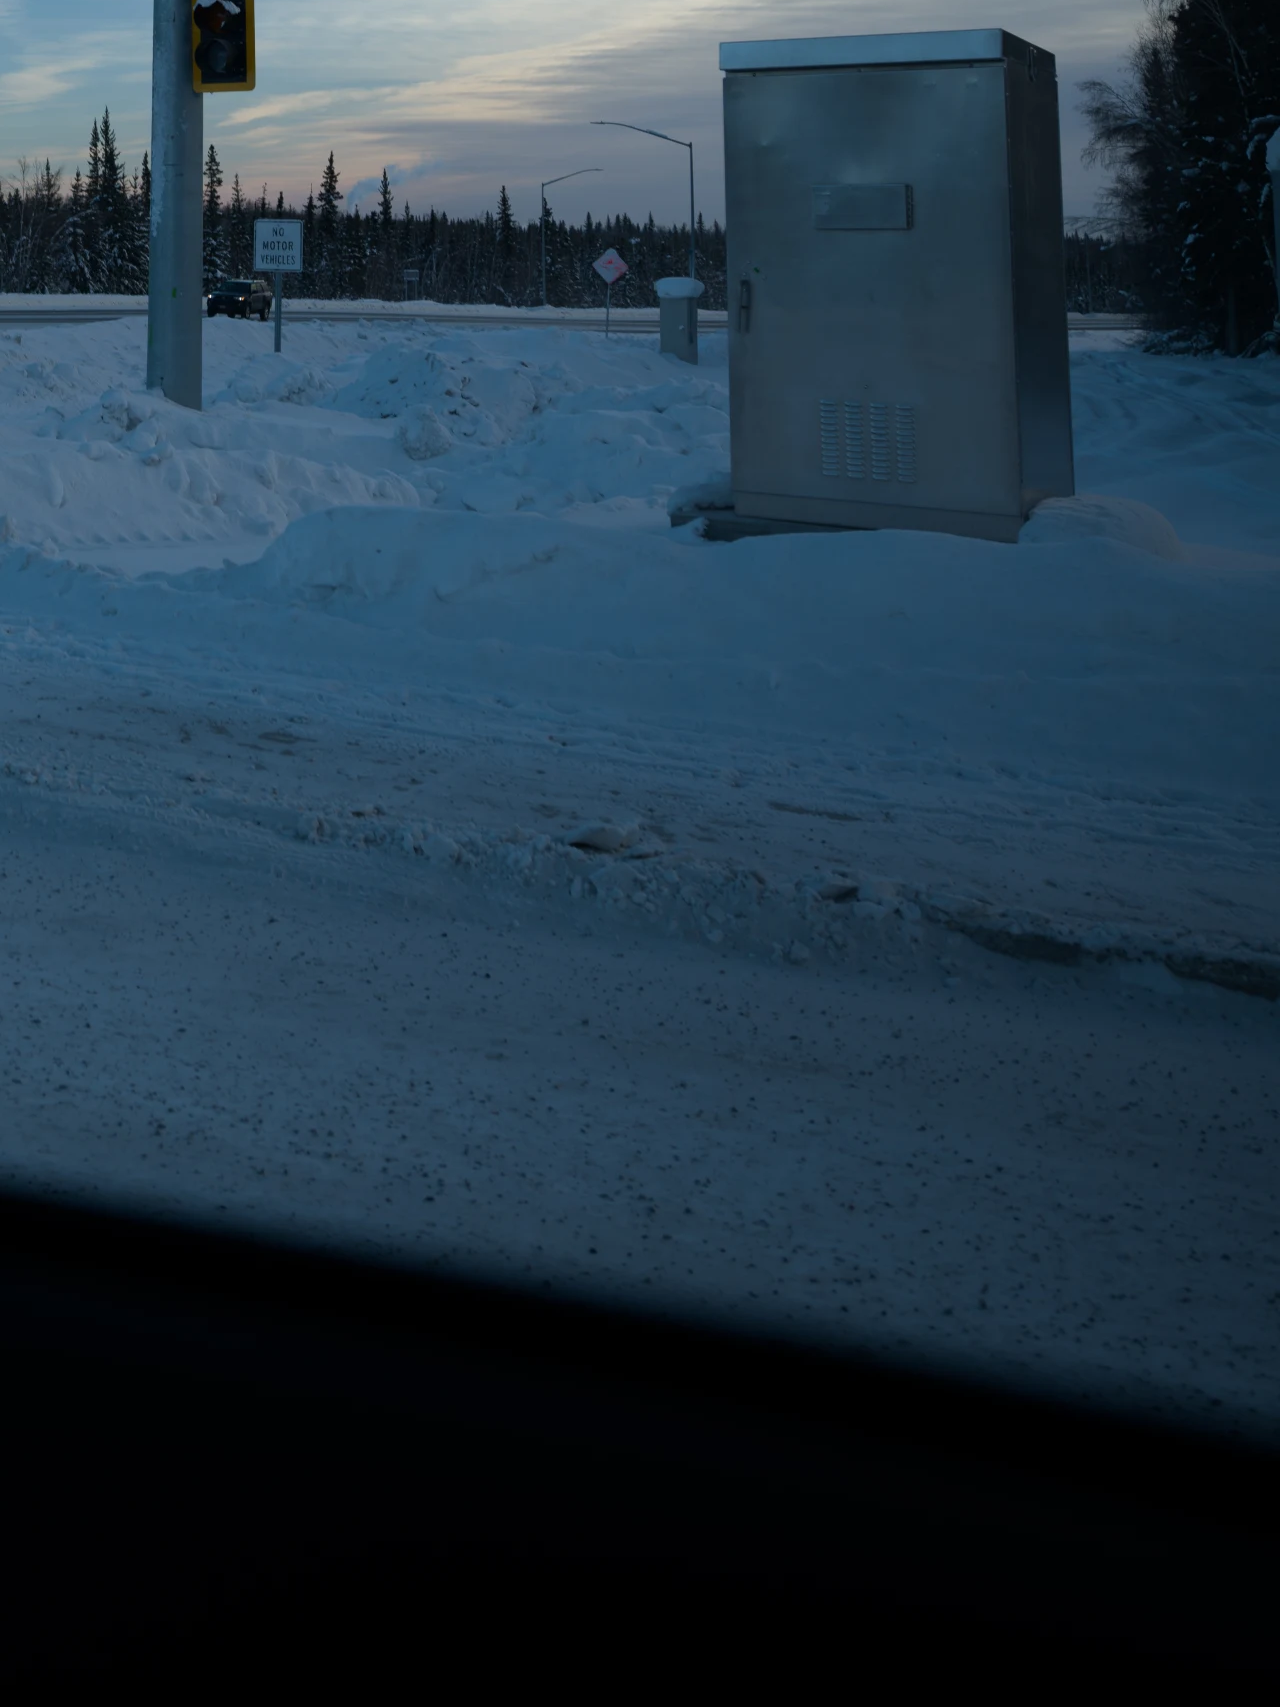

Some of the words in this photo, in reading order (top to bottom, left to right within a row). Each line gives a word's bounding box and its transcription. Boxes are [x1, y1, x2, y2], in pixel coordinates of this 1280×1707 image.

[272, 227, 285, 237] NO
[262, 241, 294, 251] MOTOR
[260, 254, 296, 265] VEHICLES
